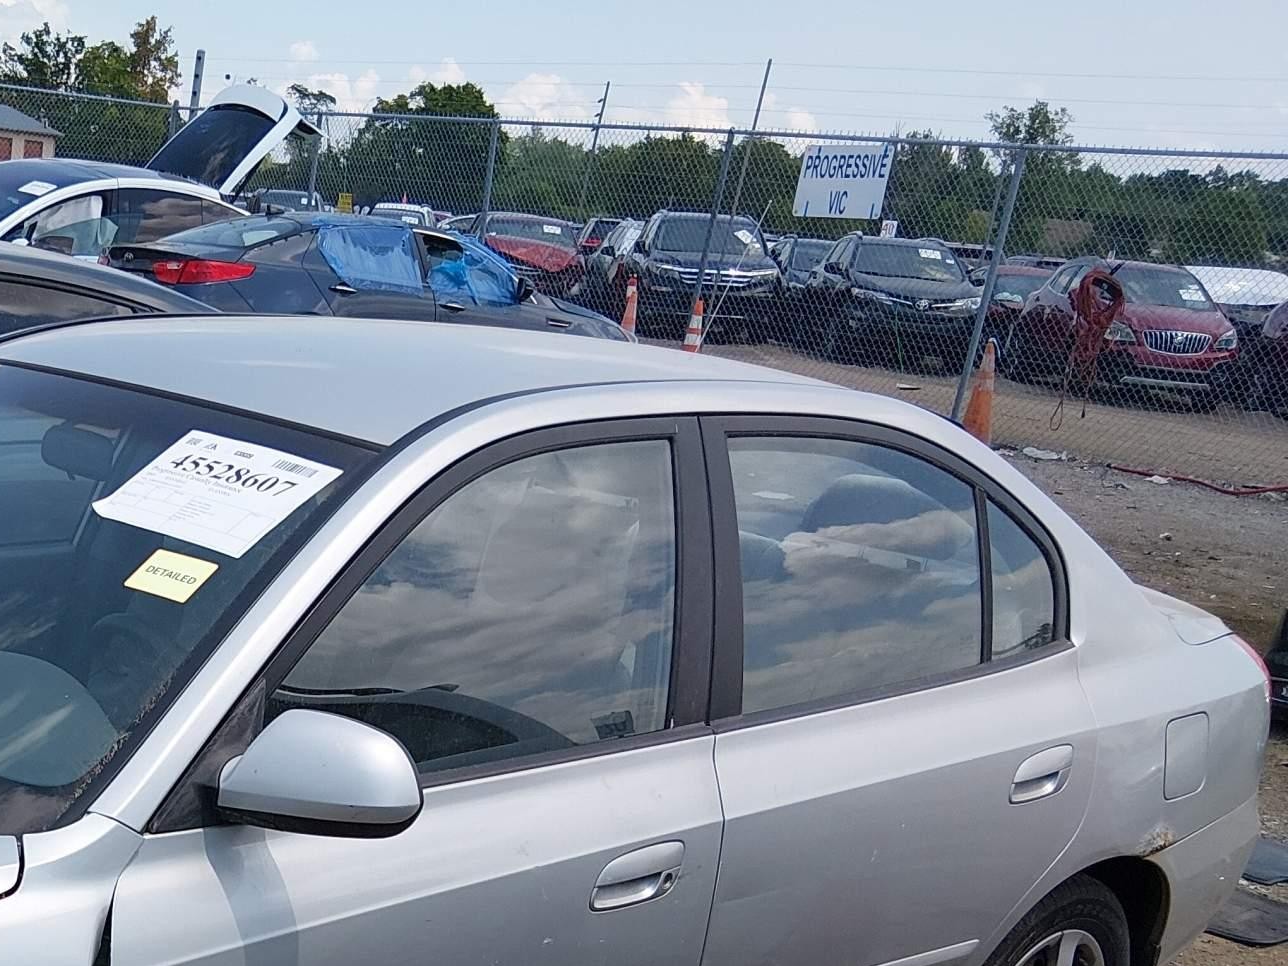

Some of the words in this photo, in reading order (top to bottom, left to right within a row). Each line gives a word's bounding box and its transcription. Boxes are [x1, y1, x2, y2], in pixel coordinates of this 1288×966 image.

[803, 153, 889, 179] PROGRESSIVE
[828, 190, 848, 215] VIC
[171, 454, 299, 497] 45528607
[145, 564, 197, 585] DETAILED
